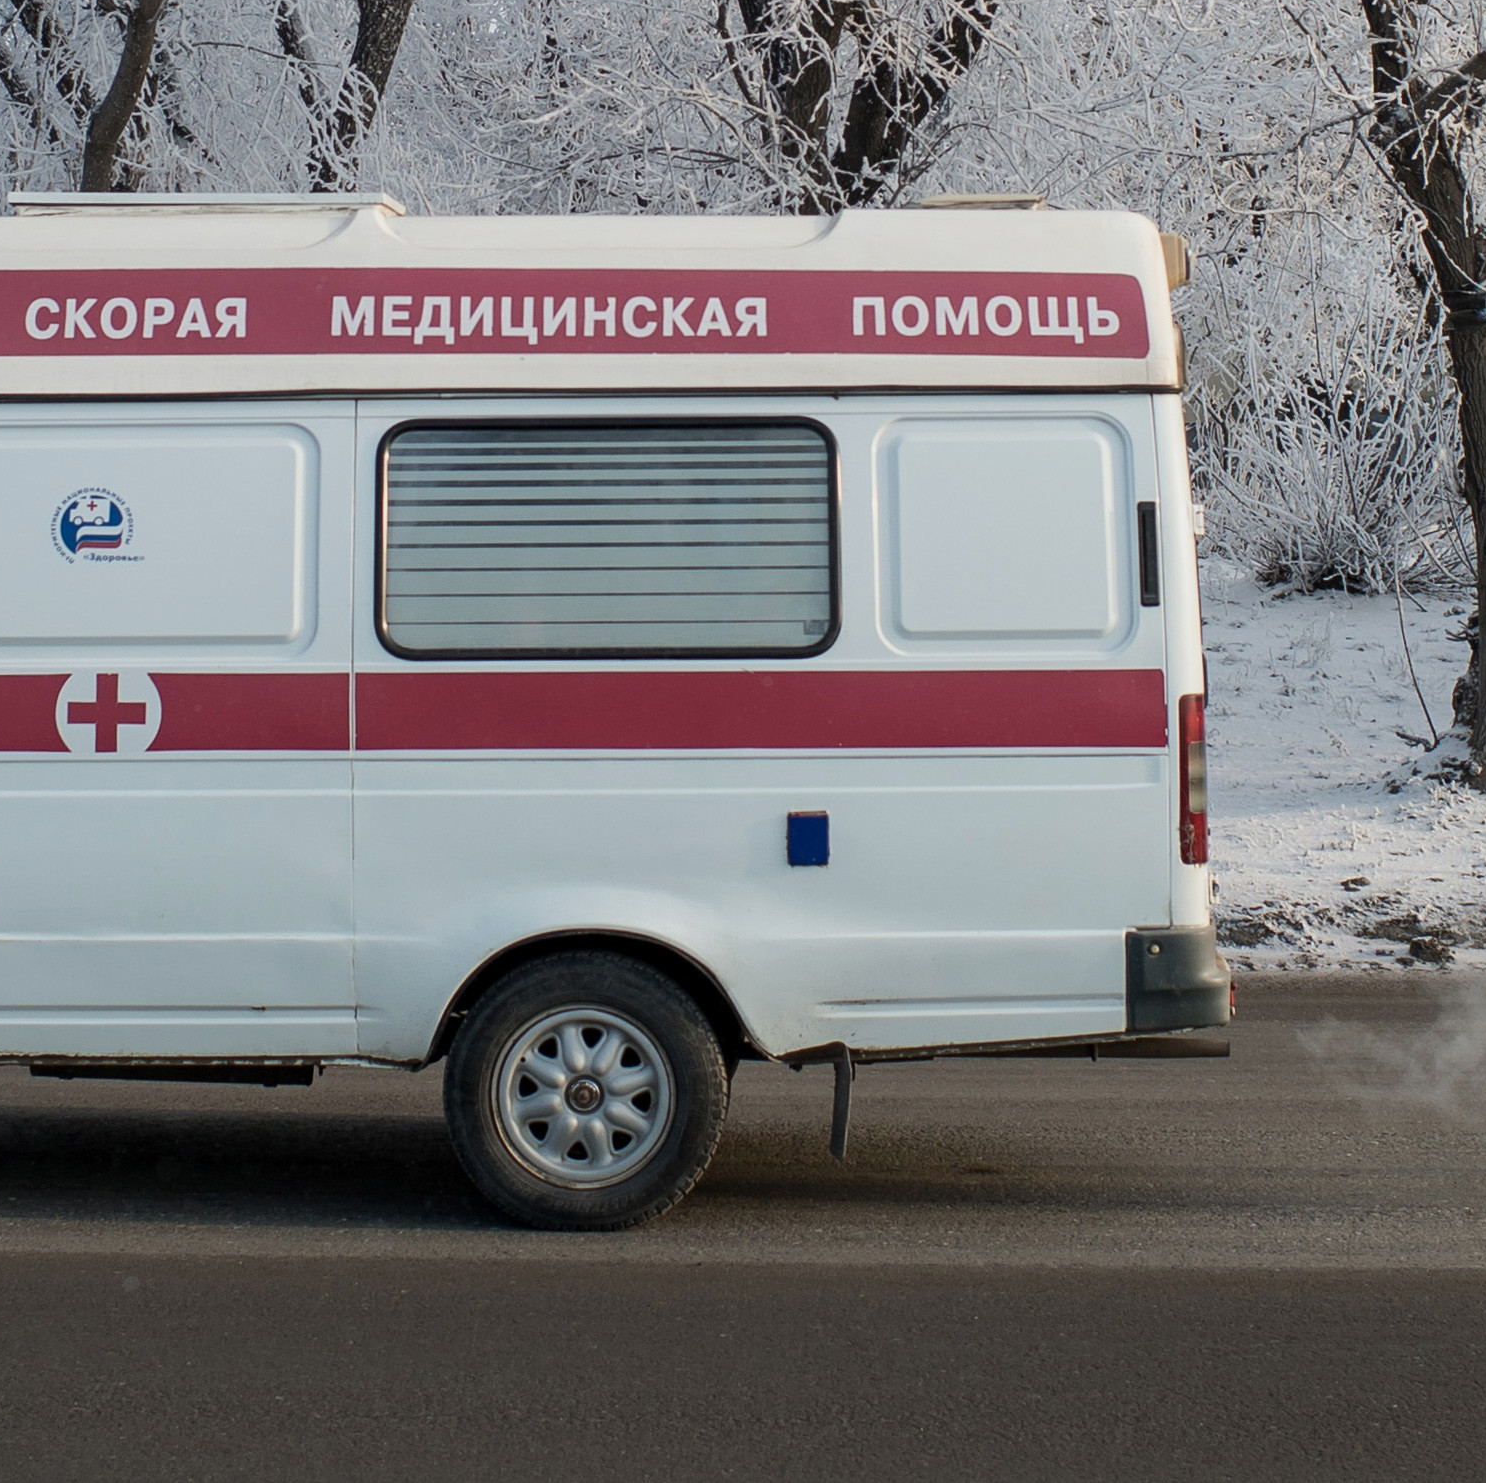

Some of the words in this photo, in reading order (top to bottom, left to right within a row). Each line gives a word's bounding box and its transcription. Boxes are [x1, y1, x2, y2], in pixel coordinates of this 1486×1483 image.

[25, 297, 247, 340] СКОРАЯ
[331, 295, 768, 345] МЕДИЦИНСКАЯ
[852, 294, 1121, 344] ПОМОЩЬ
